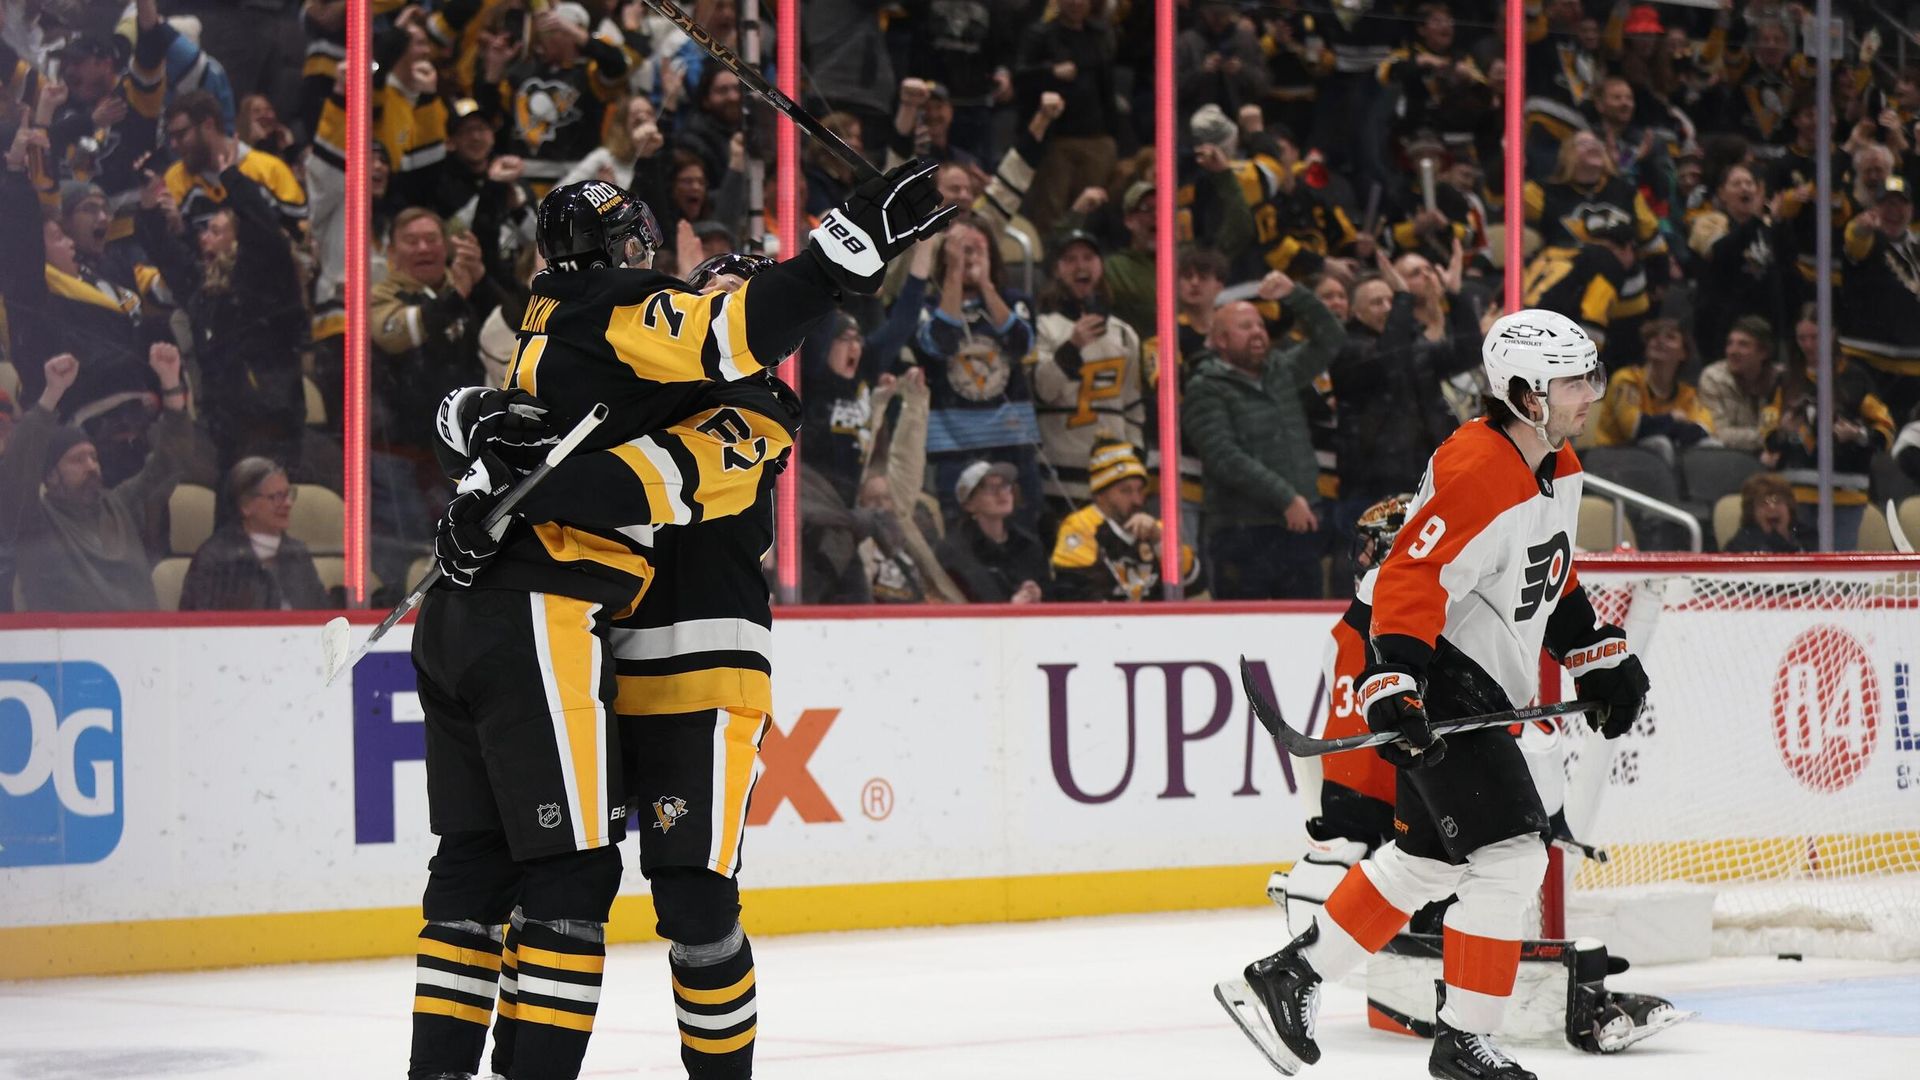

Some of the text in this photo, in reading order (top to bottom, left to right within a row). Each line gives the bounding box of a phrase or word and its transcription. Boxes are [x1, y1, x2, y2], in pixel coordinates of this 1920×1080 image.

[659, 1, 739, 71] TACKS
[582, 182, 618, 209] BOLD
[821, 212, 867, 254] BAU
[520, 294, 561, 333] LKIN
[1504, 339, 1543, 347] CHEVROLET
[1407, 515, 1447, 559] 9
[1037, 660, 1326, 804] UPM
[1519, 708, 1543, 718] BAUER
